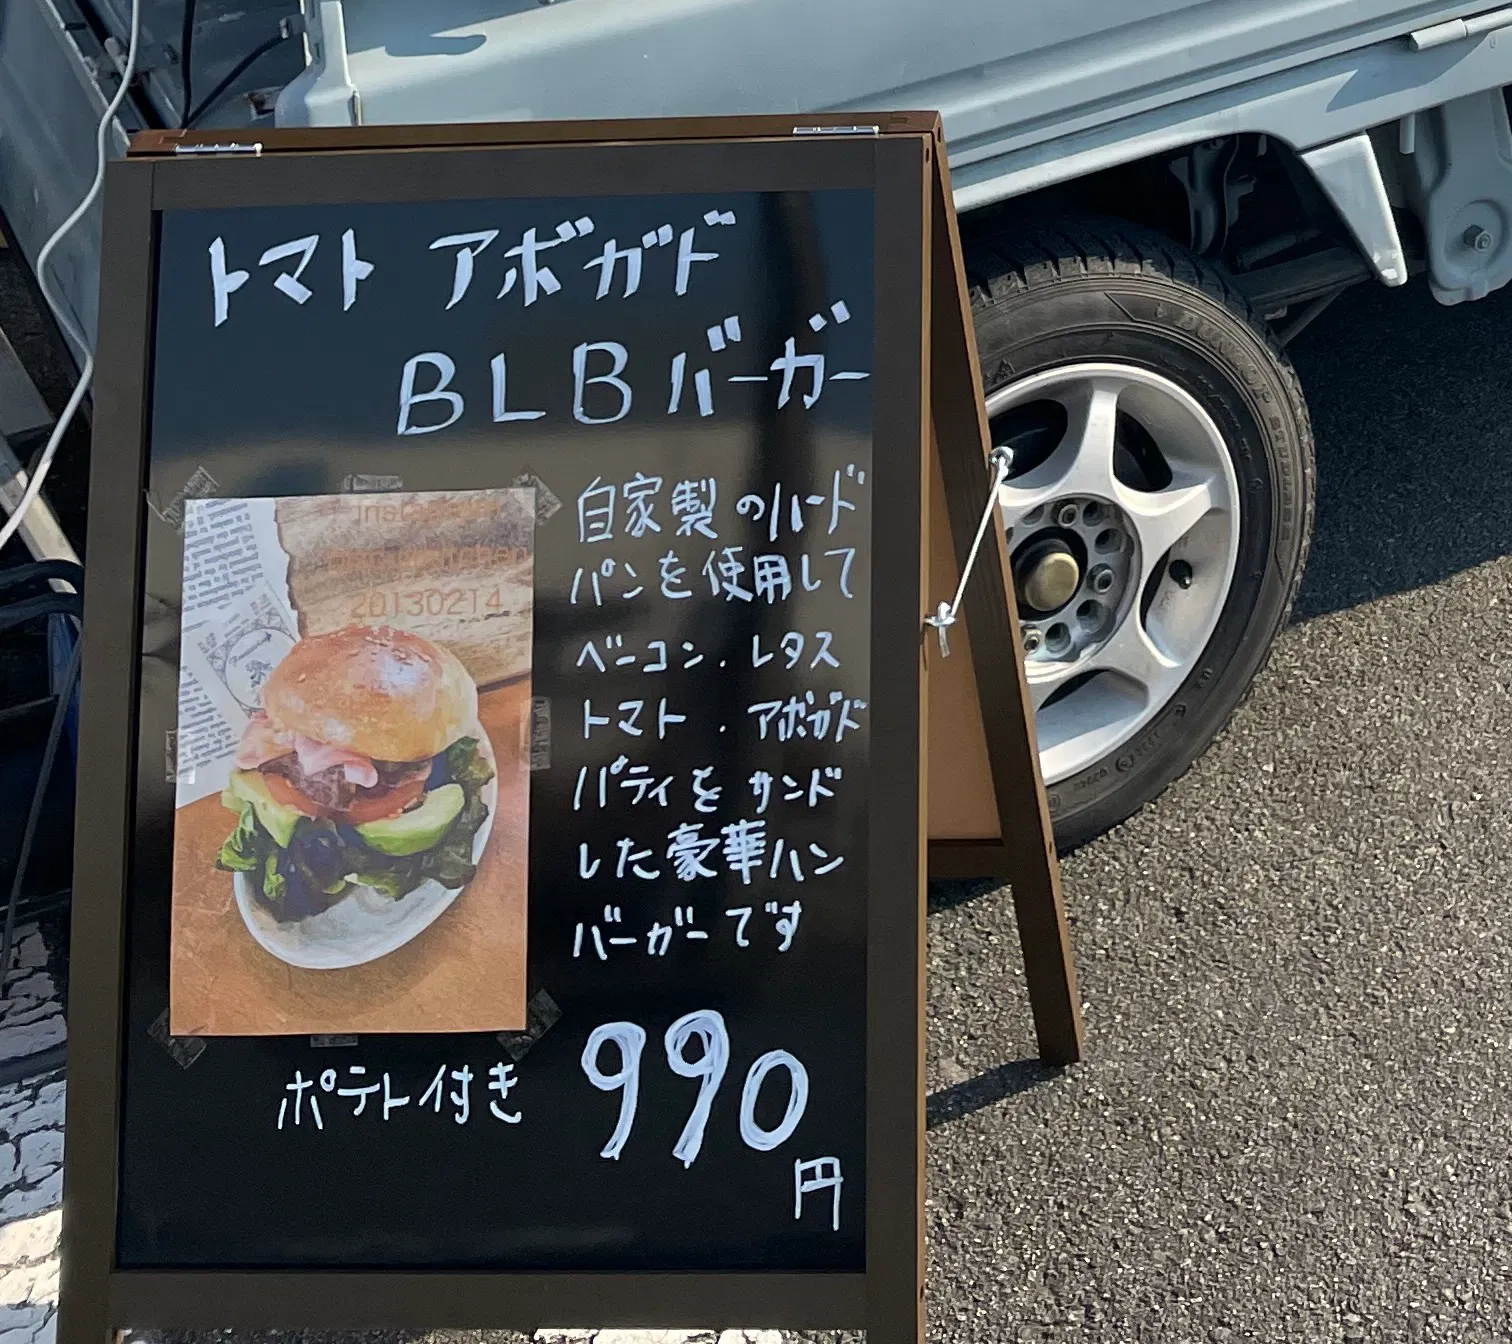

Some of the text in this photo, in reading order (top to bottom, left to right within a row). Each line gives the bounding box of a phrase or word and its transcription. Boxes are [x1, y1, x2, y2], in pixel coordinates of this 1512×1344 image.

[208, 209, 736, 327] トマト アボガド
[570, 545, 856, 606] パンを使用して
[579, 819, 844, 885] した豪華ハン
[277, 1061, 523, 1130] ポテト付き
